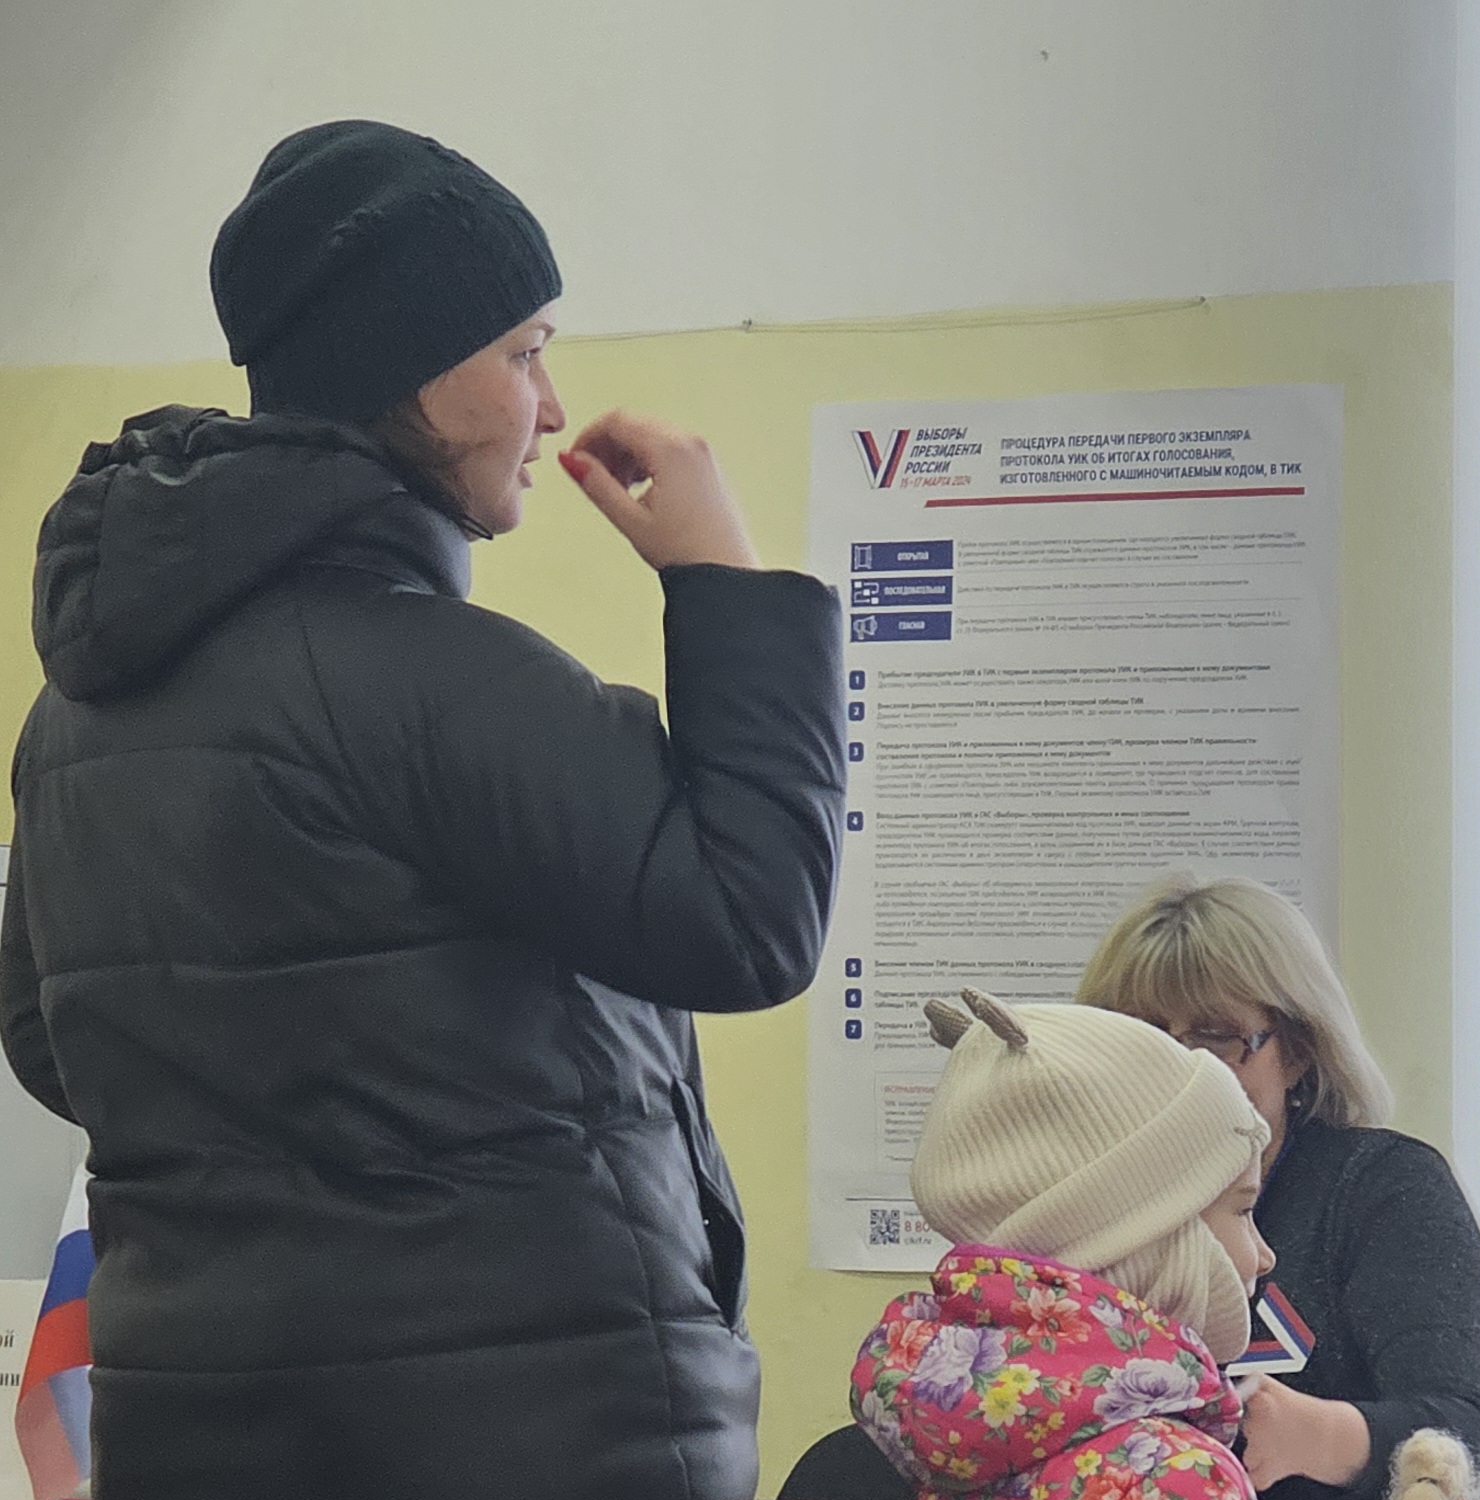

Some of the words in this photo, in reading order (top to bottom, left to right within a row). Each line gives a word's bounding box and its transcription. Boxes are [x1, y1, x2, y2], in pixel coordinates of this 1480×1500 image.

[916, 427, 968, 441] ВЫБОРЫ
[1001, 436, 1065, 450] ПРОЦЕДУРА
[1068, 434, 1125, 448] ПЕРЕДАЧИ
[1128, 432, 1176, 445] ПЕРВОГО
[1178, 429, 1251, 443] ЭКЗЕМПЛЯРА
[910, 443, 982, 458] ПРЕЗИДЕНТА
[1000, 454, 1065, 467] ПРОТОКОЛА
[1067, 453, 1089, 465] УИК
[1091, 452, 1105, 464] ОБ
[1107, 451, 1150, 464] ИТОГАХ
[1153, 448, 1235, 462] ГОЛОСОВАНИЯ,
[904, 461, 951, 474] РОССИИ
[1000, 470, 1097, 484] ИЗГОТОВЛЕННОГО
[1099, 469, 1107, 480] С
[1109, 465, 1222, 480] МАШИНОЧИТАЕМЫМ
[1224, 464, 1268, 478] КОДОМ,
[1270, 463, 1277, 475] В
[1280, 462, 1302, 475] ТИК
[922, 476, 951, 487] МАРТА
[952, 475, 972, 486] 2024
[904, 1221, 912, 1232] 8
[915, 1221, 931, 1232] 80
